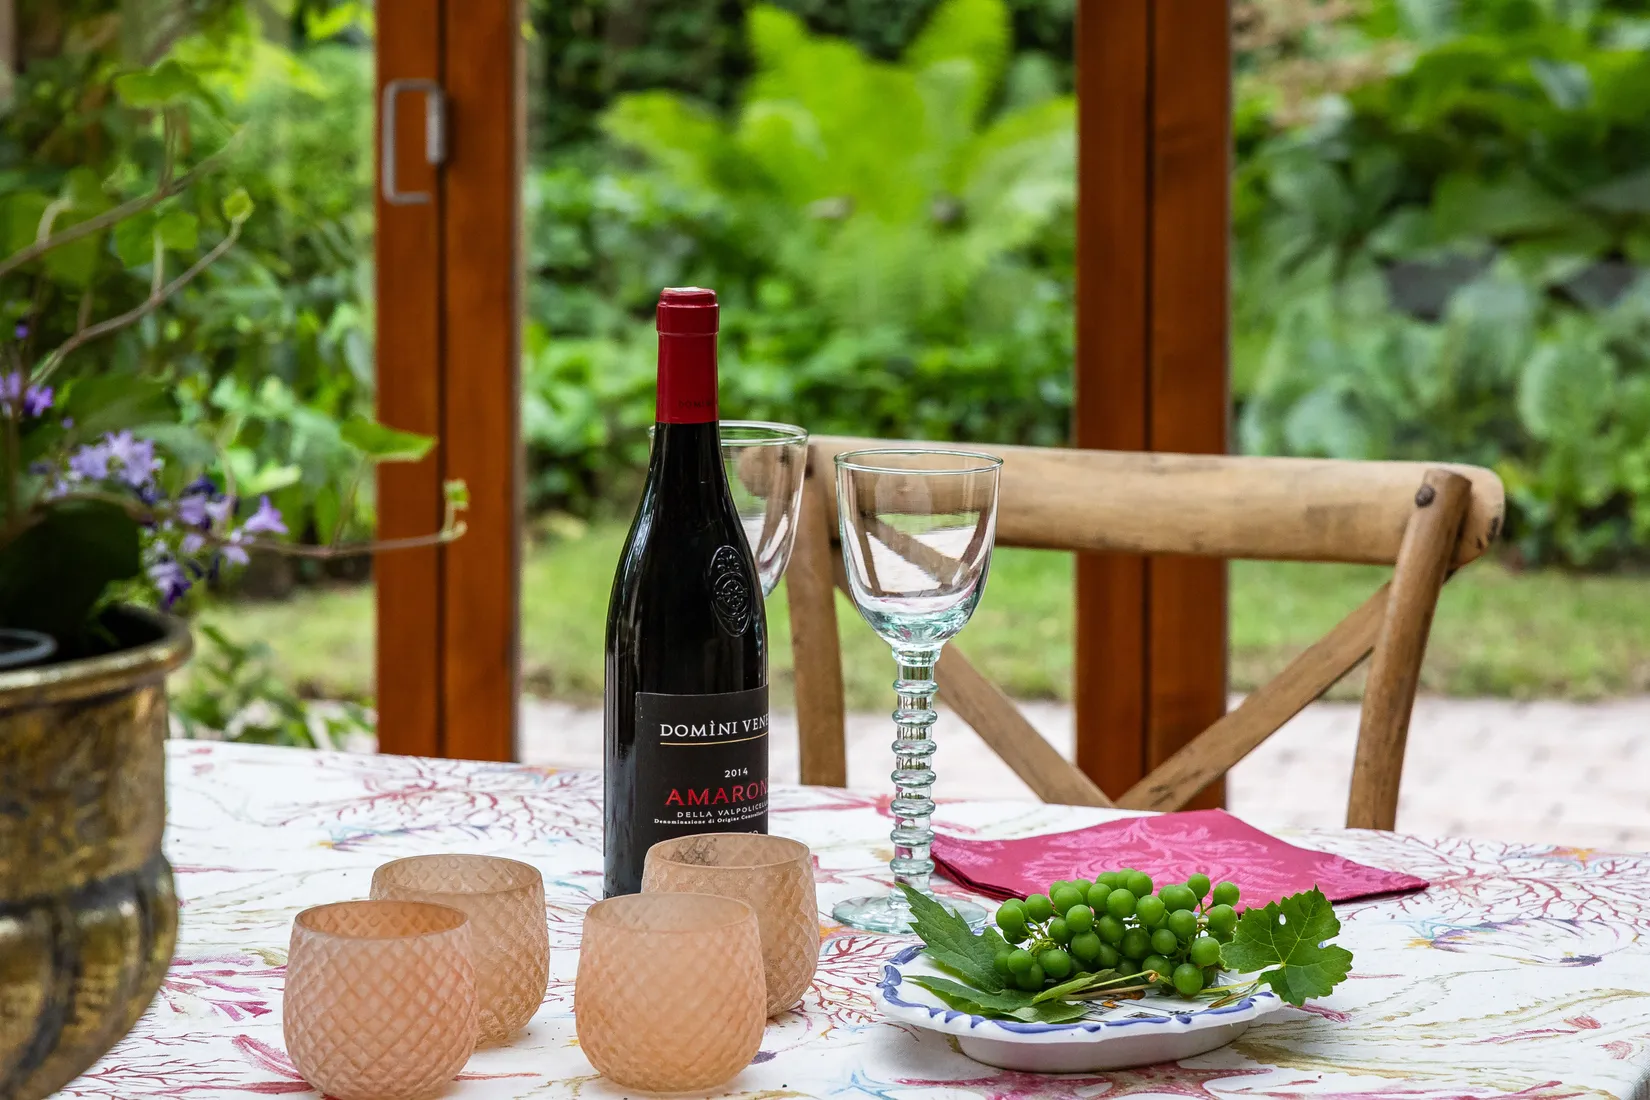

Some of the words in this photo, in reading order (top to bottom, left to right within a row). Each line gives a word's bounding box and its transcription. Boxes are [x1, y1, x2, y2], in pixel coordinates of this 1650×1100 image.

[660, 720, 738, 737] DOMÌNI
[724, 767, 749, 778] 2014
[664, 779, 768, 806] AMARON
[717, 800, 768, 816] VALPOLICELL
